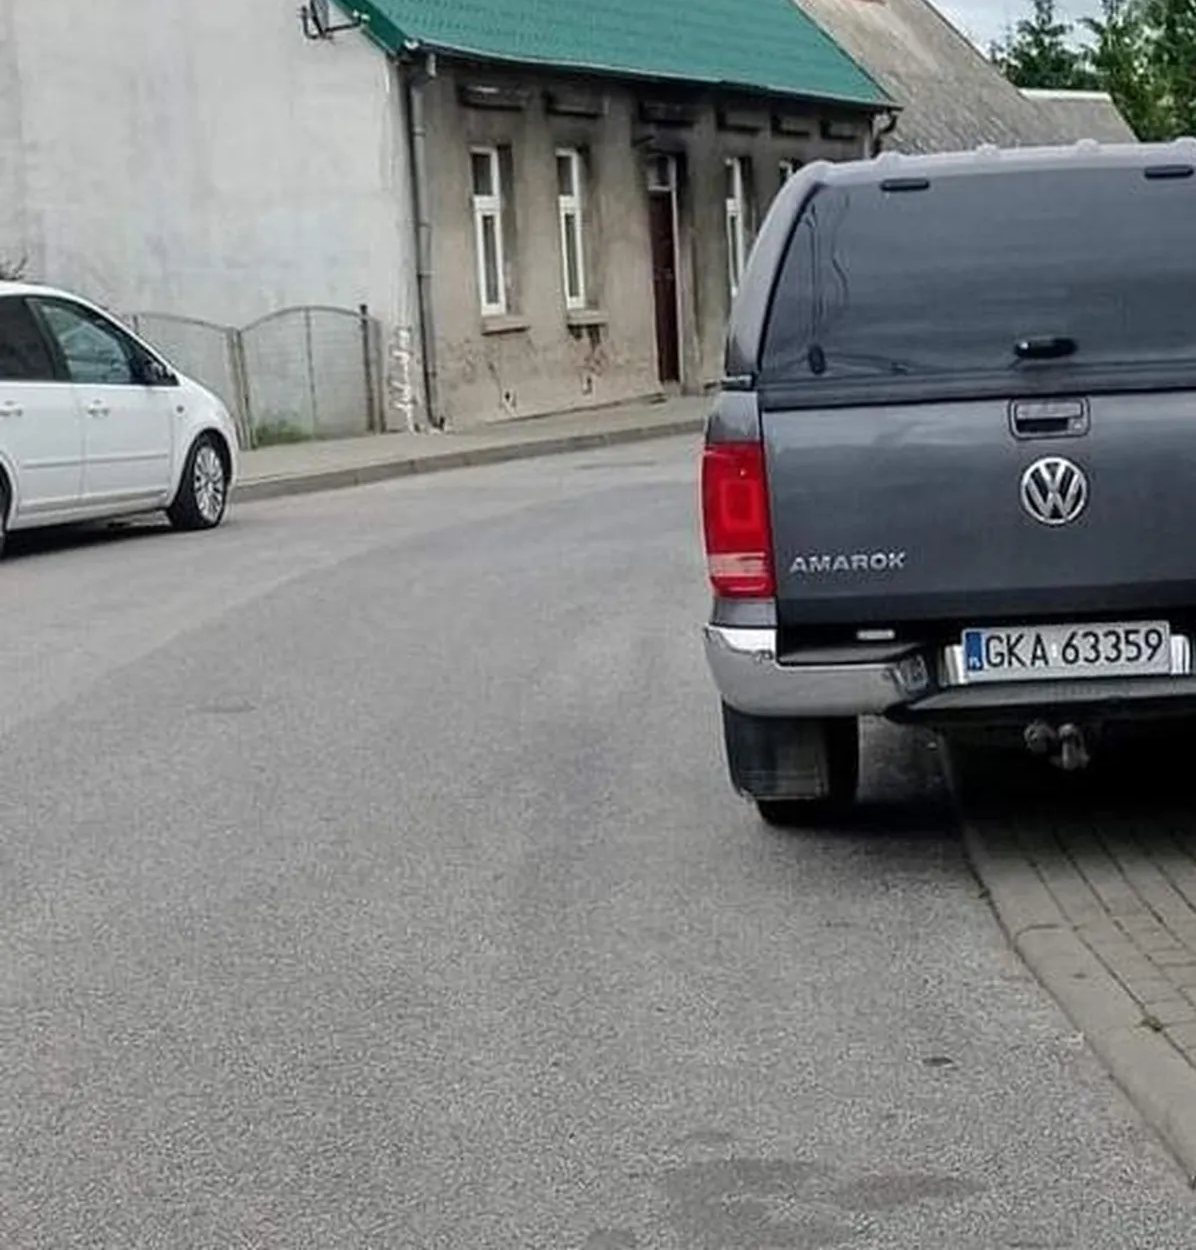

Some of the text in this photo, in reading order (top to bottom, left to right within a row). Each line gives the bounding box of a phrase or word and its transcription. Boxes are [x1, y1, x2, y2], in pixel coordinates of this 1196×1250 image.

[790, 552, 904, 573] AMAROK
[985, 629, 1162, 667] GKA 63359
